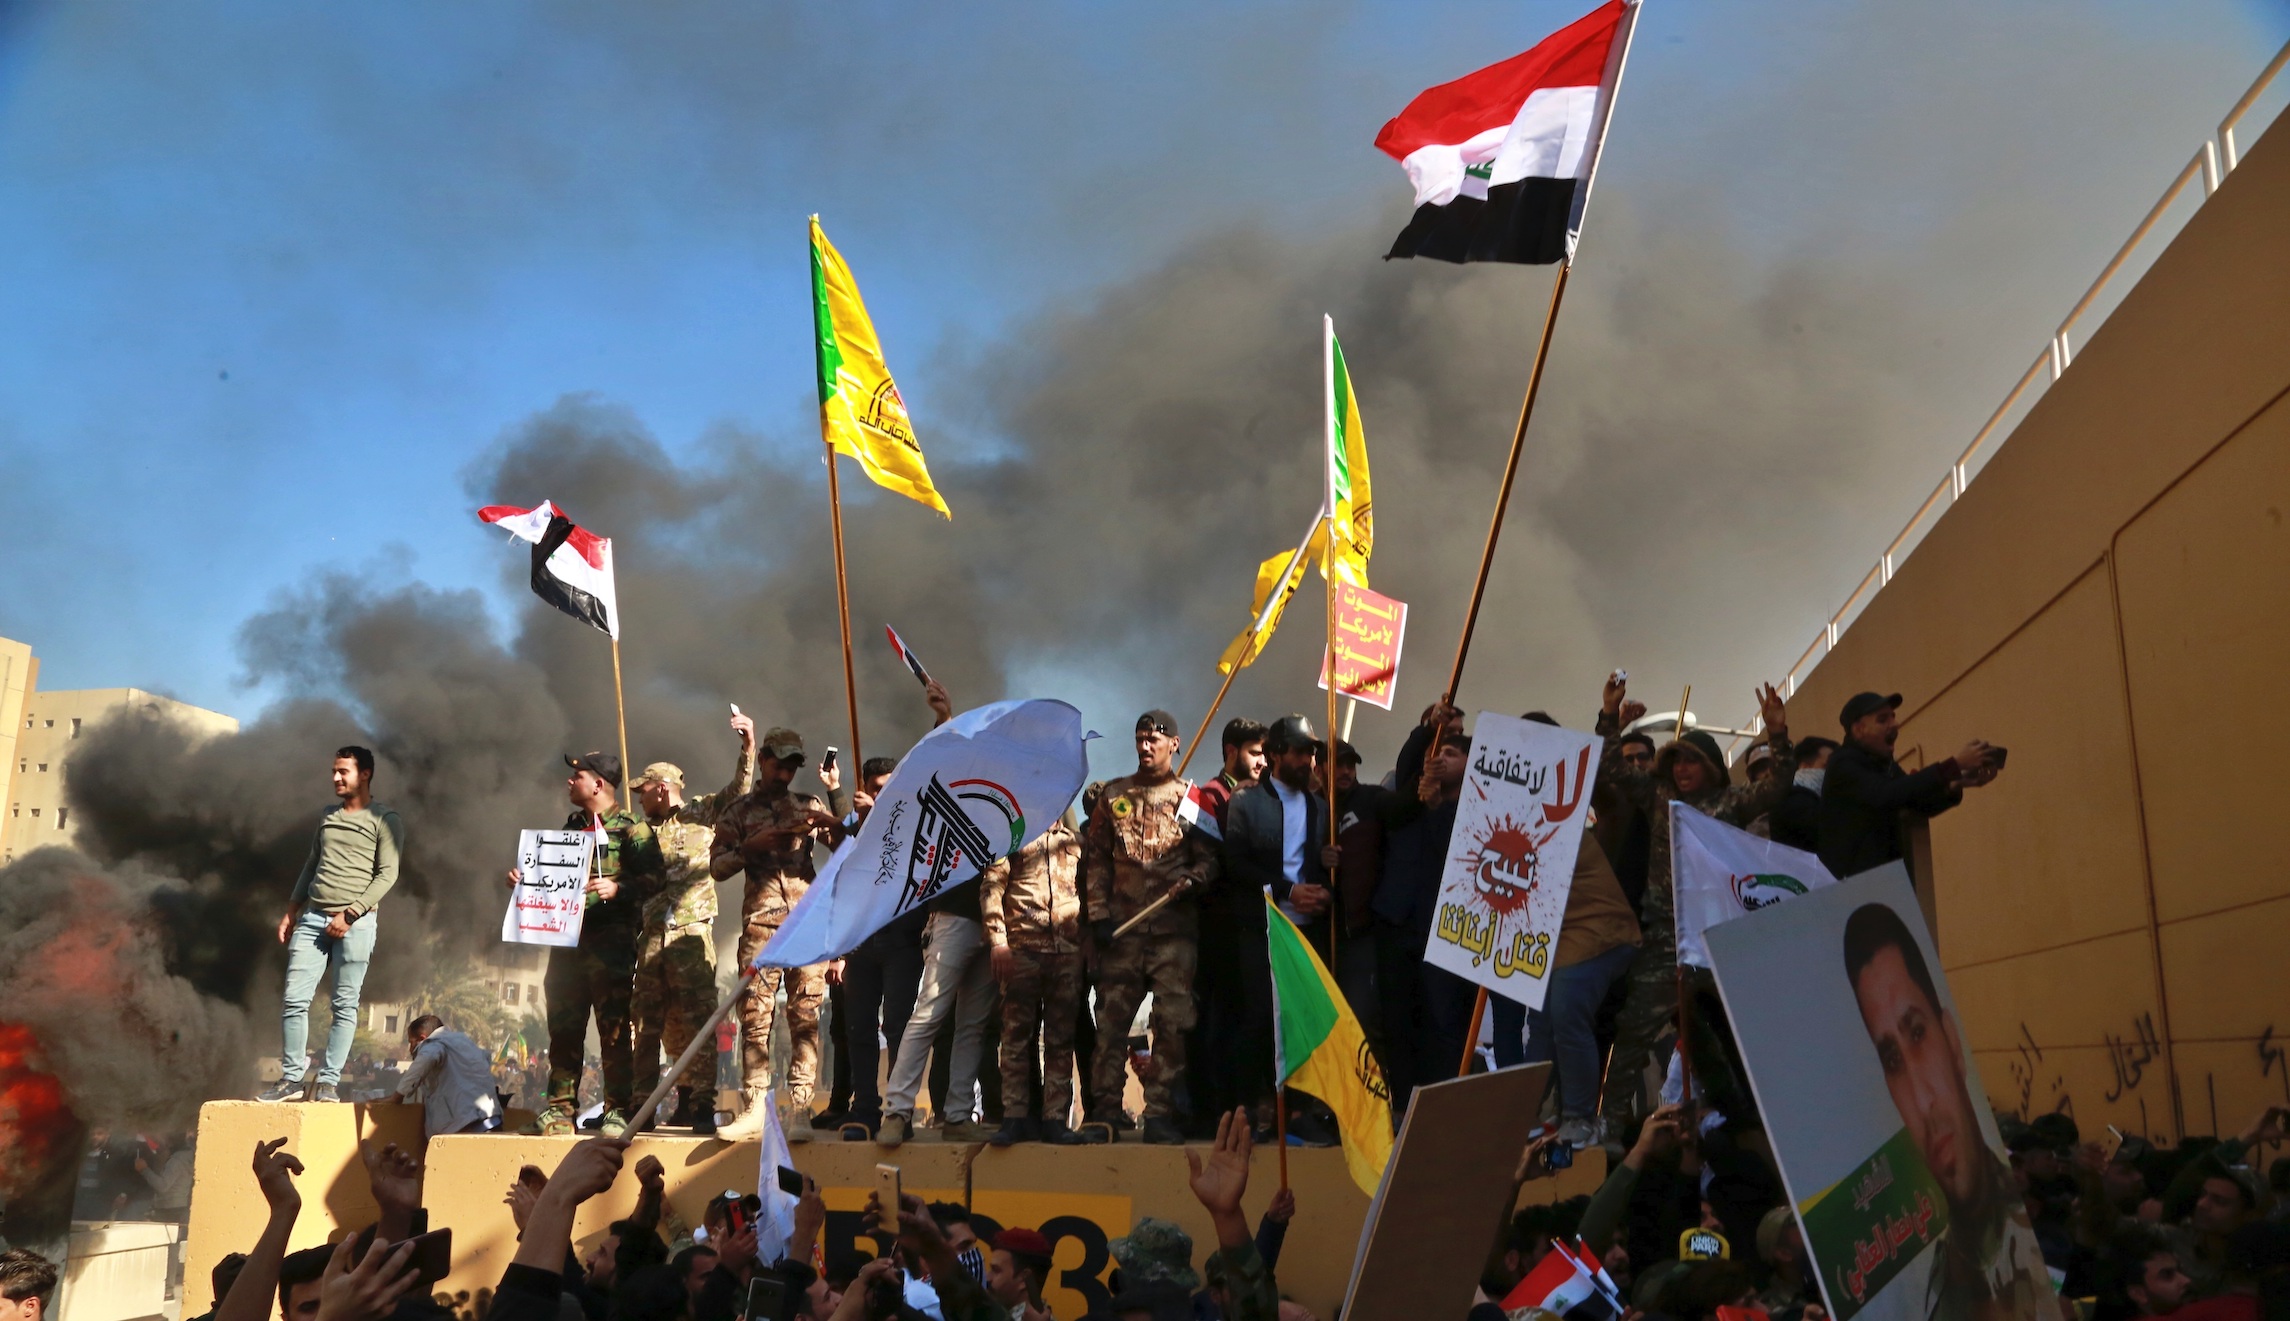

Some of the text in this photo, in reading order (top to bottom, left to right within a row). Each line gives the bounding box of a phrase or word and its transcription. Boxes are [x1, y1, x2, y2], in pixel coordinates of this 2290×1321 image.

[1343, 586, 1398, 622] الموت
[1335, 635, 1390, 671] الموت
[1473, 743, 1591, 823] لا لاتفاقية
[536, 832, 585, 851] إغلقوا
[524, 852, 584, 869] السفارة
[1474, 847, 1537, 898] تبيح
[520, 872, 581, 893] الأمريكية
[515, 895, 579, 916] وإلا سيغلقها
[518, 917, 567, 933] الشعب
[1436, 901, 1550, 980] قتل أبنائنا
[1851, 1152, 1894, 1212] الشهيد
